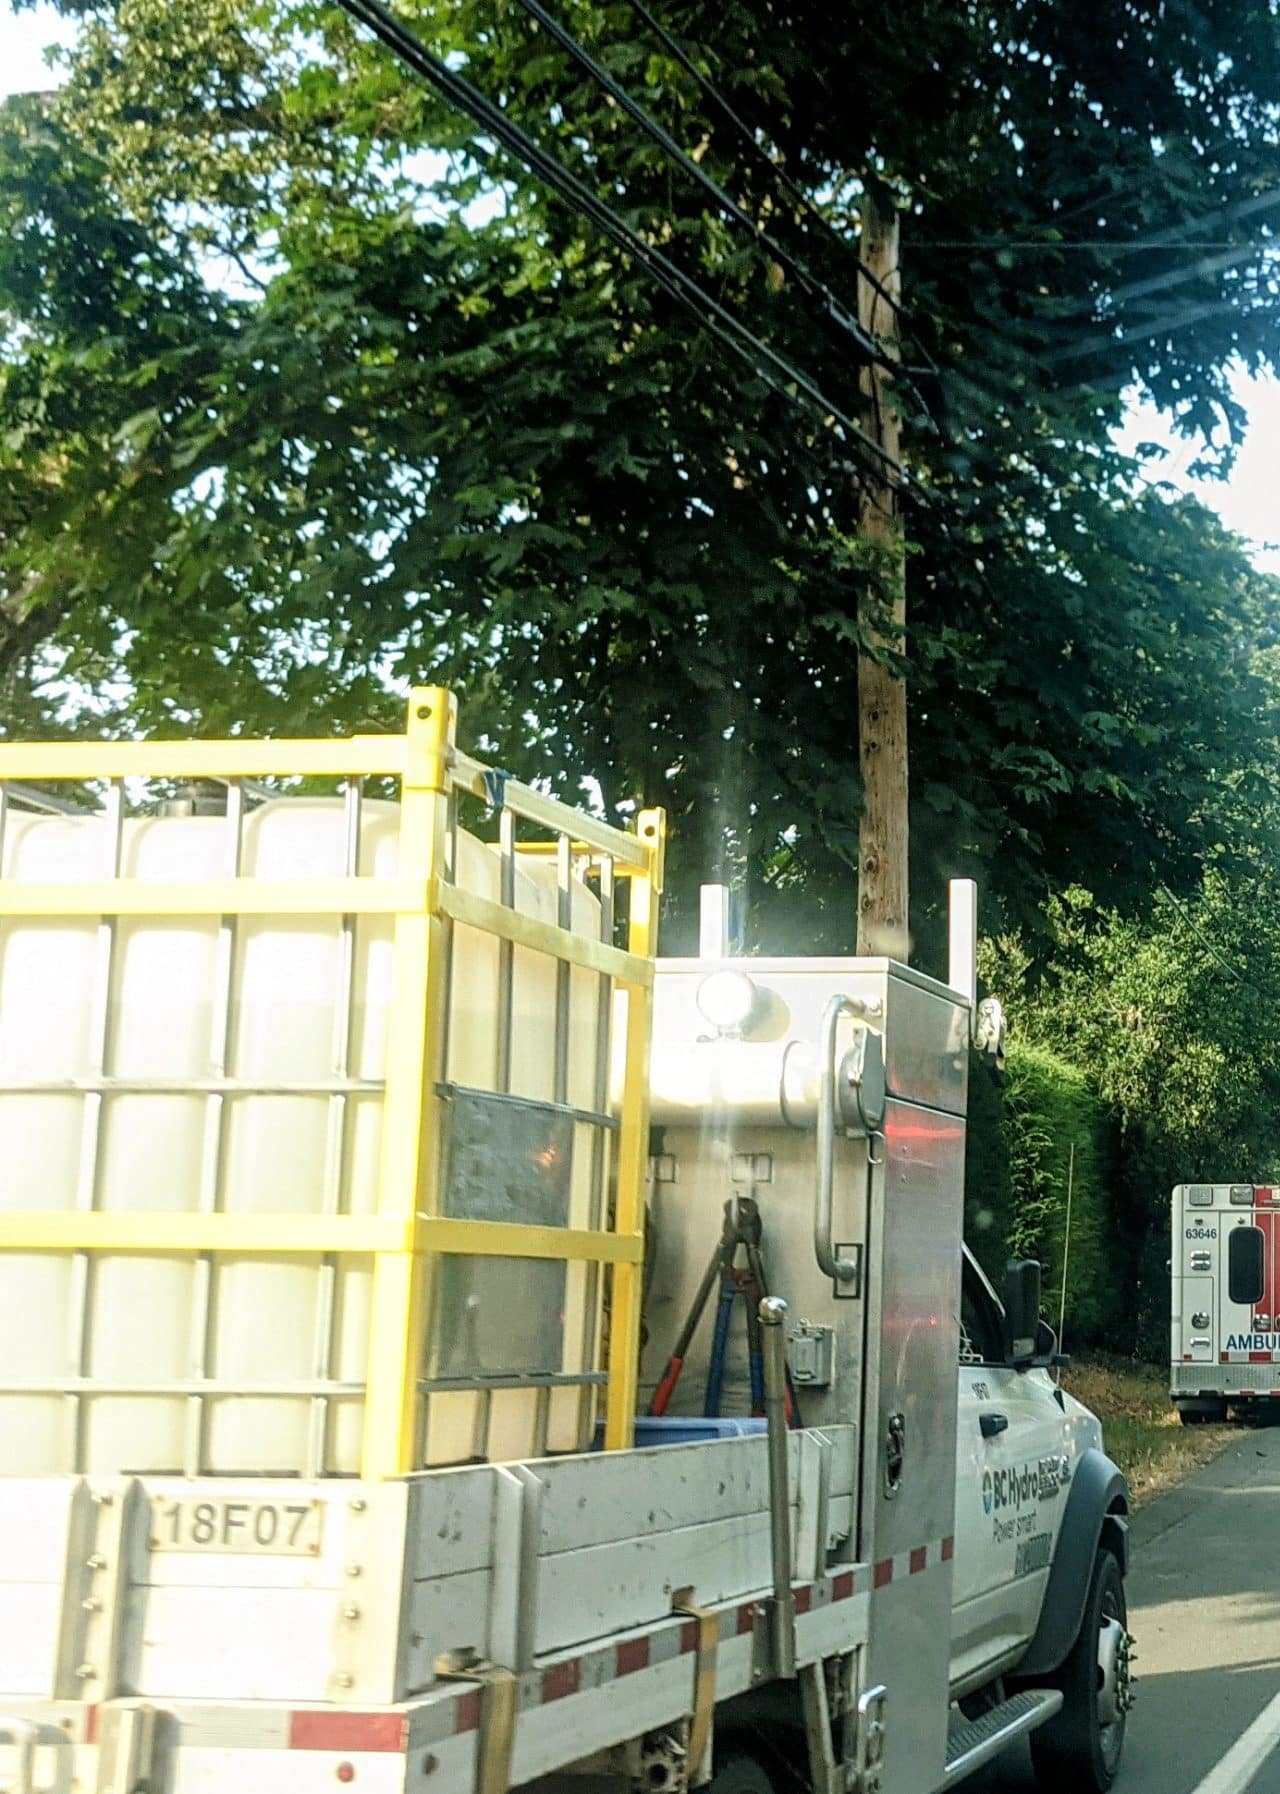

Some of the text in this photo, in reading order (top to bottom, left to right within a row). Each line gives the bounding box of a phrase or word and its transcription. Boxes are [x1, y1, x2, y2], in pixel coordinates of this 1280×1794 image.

[1185, 1228, 1217, 1239] 63646
[993, 1468, 1008, 1510] BC
[1008, 1463, 1039, 1512] Hydro
[162, 1502, 310, 1546] 18F07
